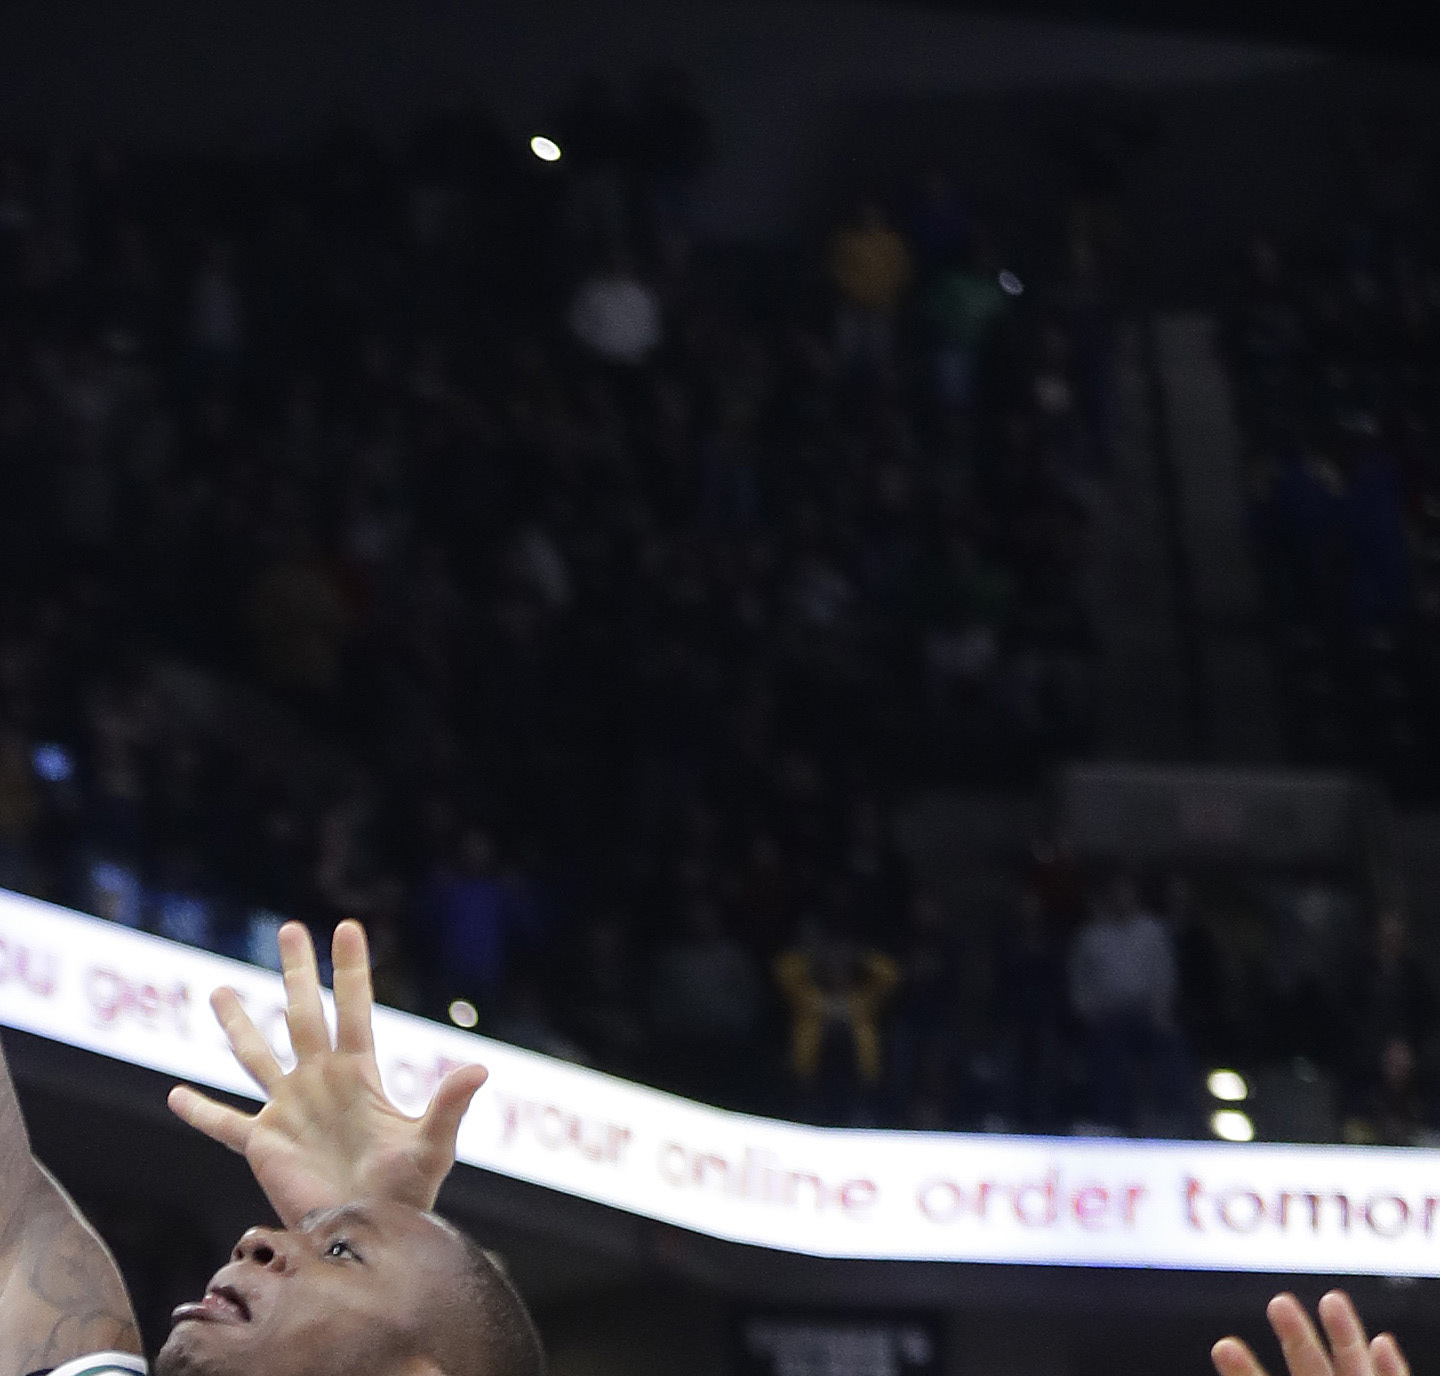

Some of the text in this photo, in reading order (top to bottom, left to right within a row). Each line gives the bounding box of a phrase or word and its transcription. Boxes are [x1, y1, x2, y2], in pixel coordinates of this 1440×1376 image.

[85, 962, 196, 1036] get
[496, 1092, 632, 1166] your
[661, 1142, 880, 1220] online
[916, 1164, 1150, 1230] order
